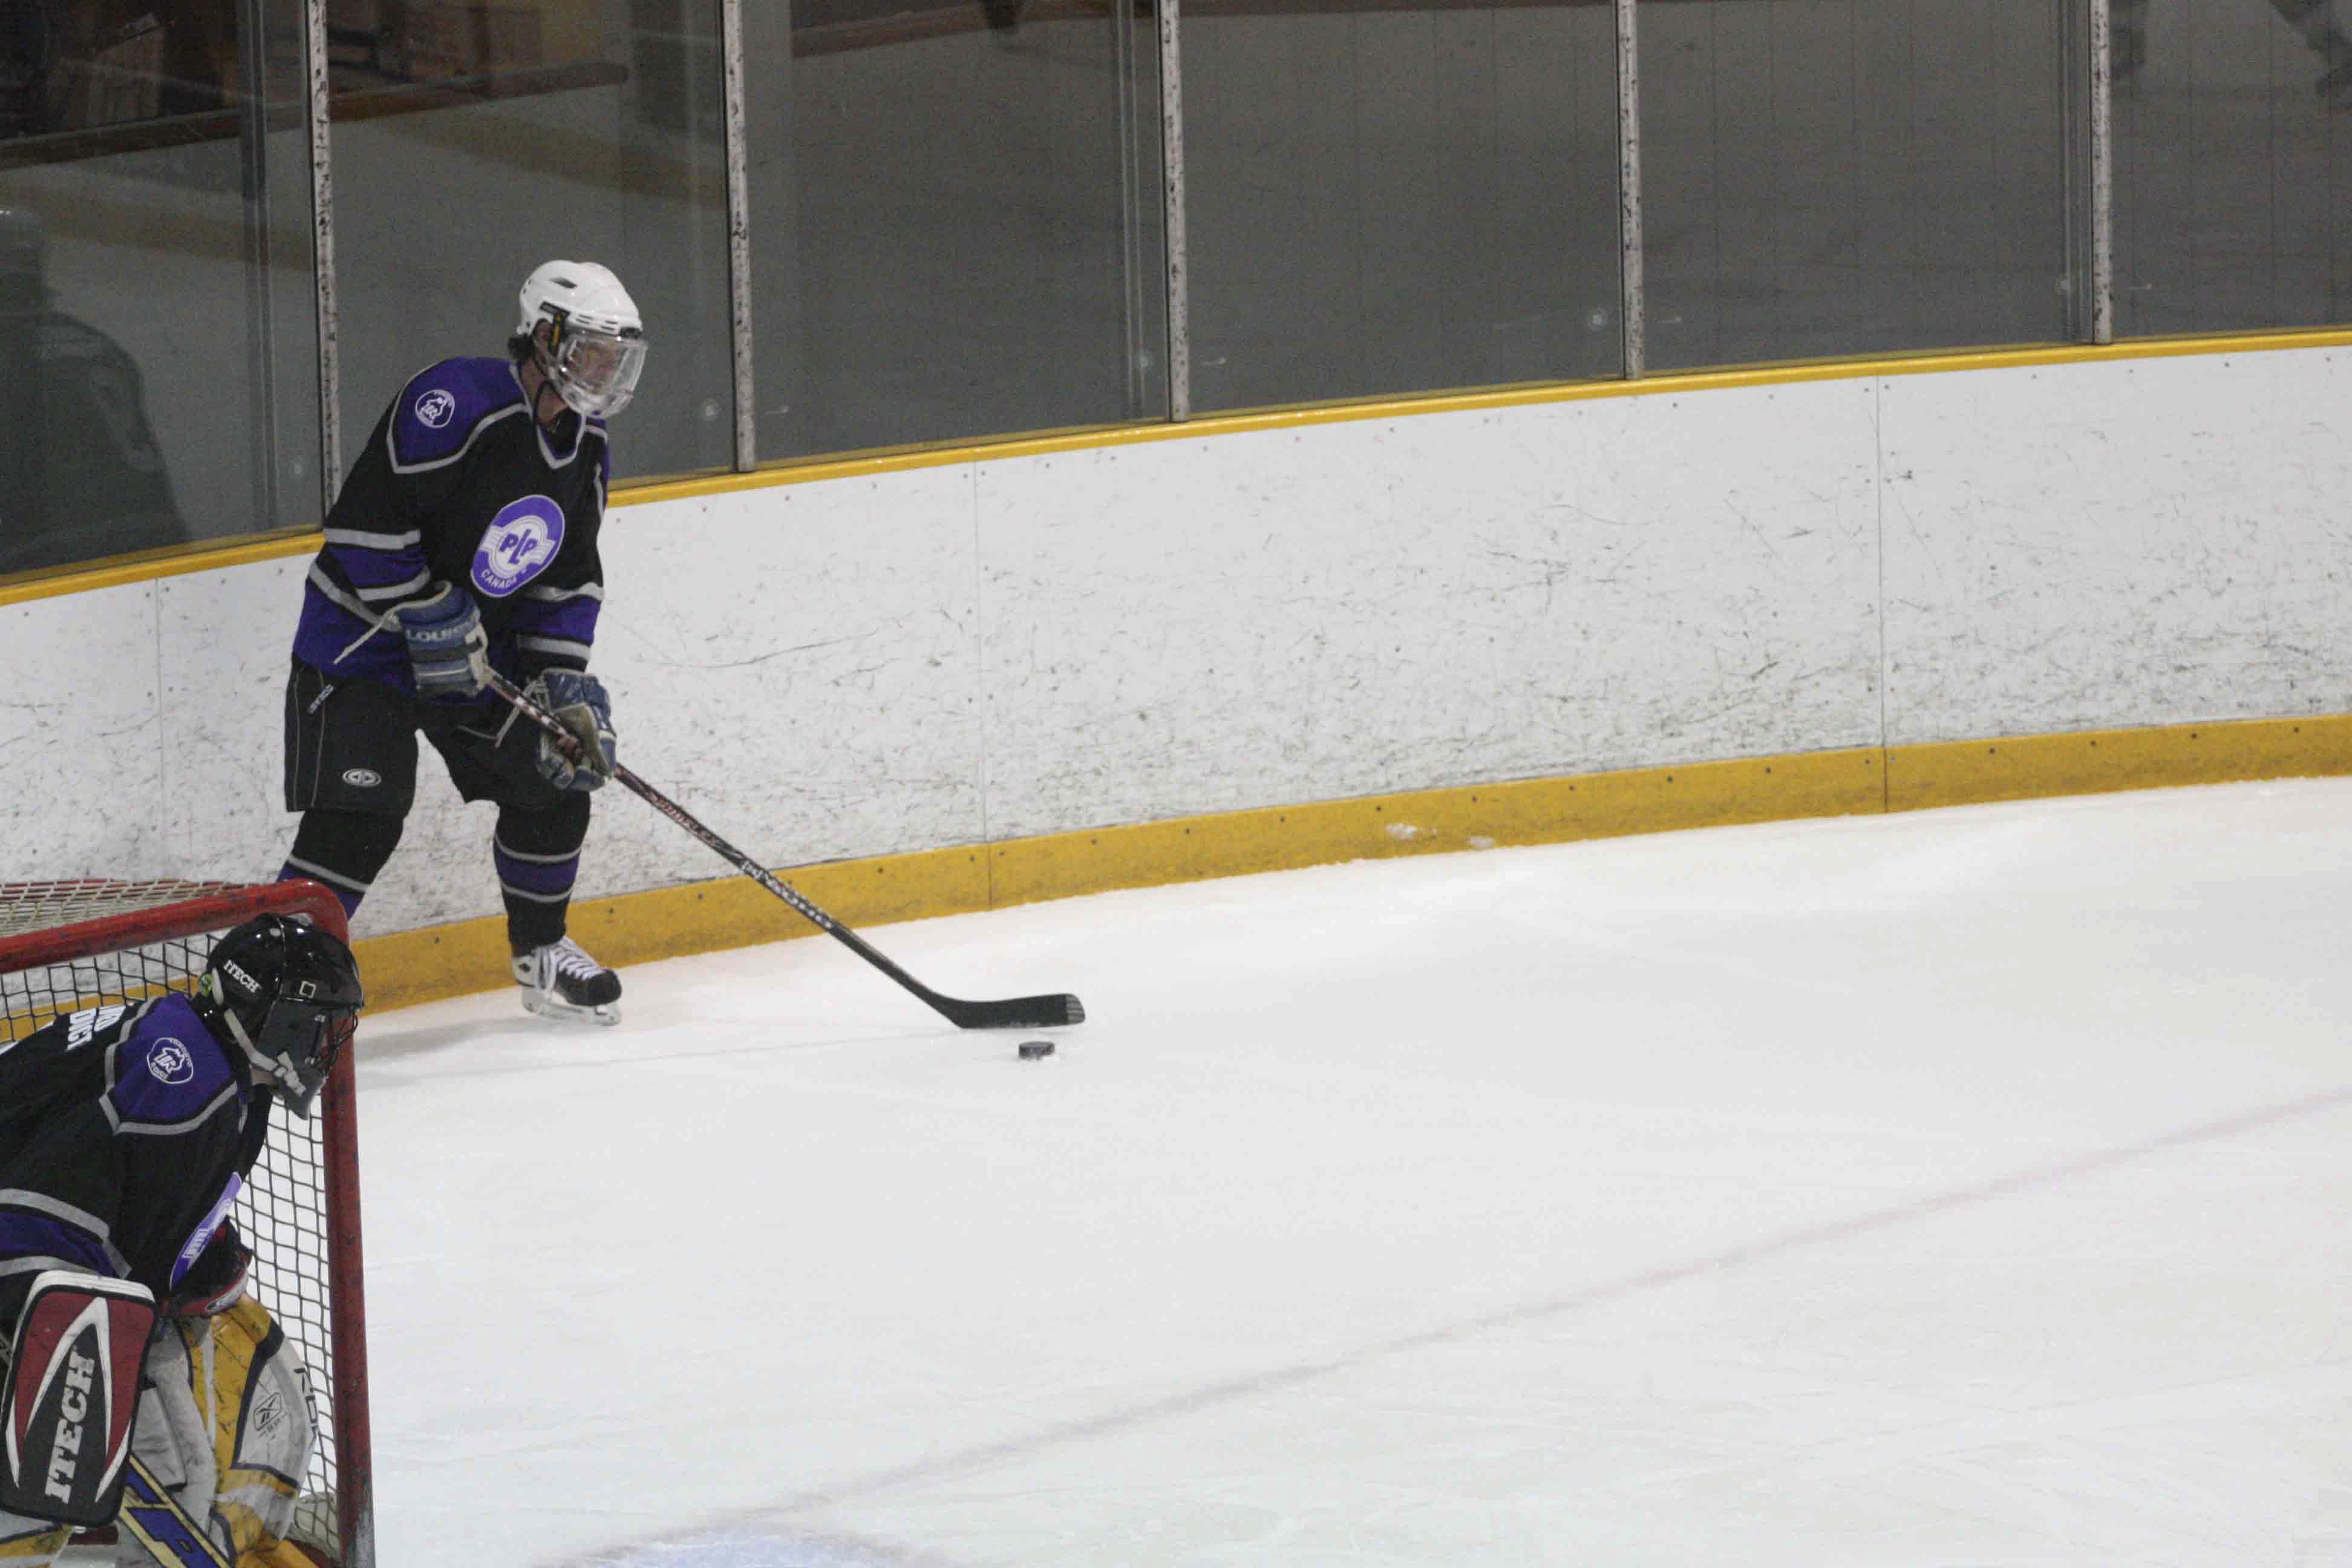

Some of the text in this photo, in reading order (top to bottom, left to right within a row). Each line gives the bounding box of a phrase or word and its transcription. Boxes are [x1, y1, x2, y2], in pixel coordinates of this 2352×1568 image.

[481, 569, 517, 589] CANADA
[223, 959, 261, 993] ITECH
[44, 1350, 95, 1504] ITECH
